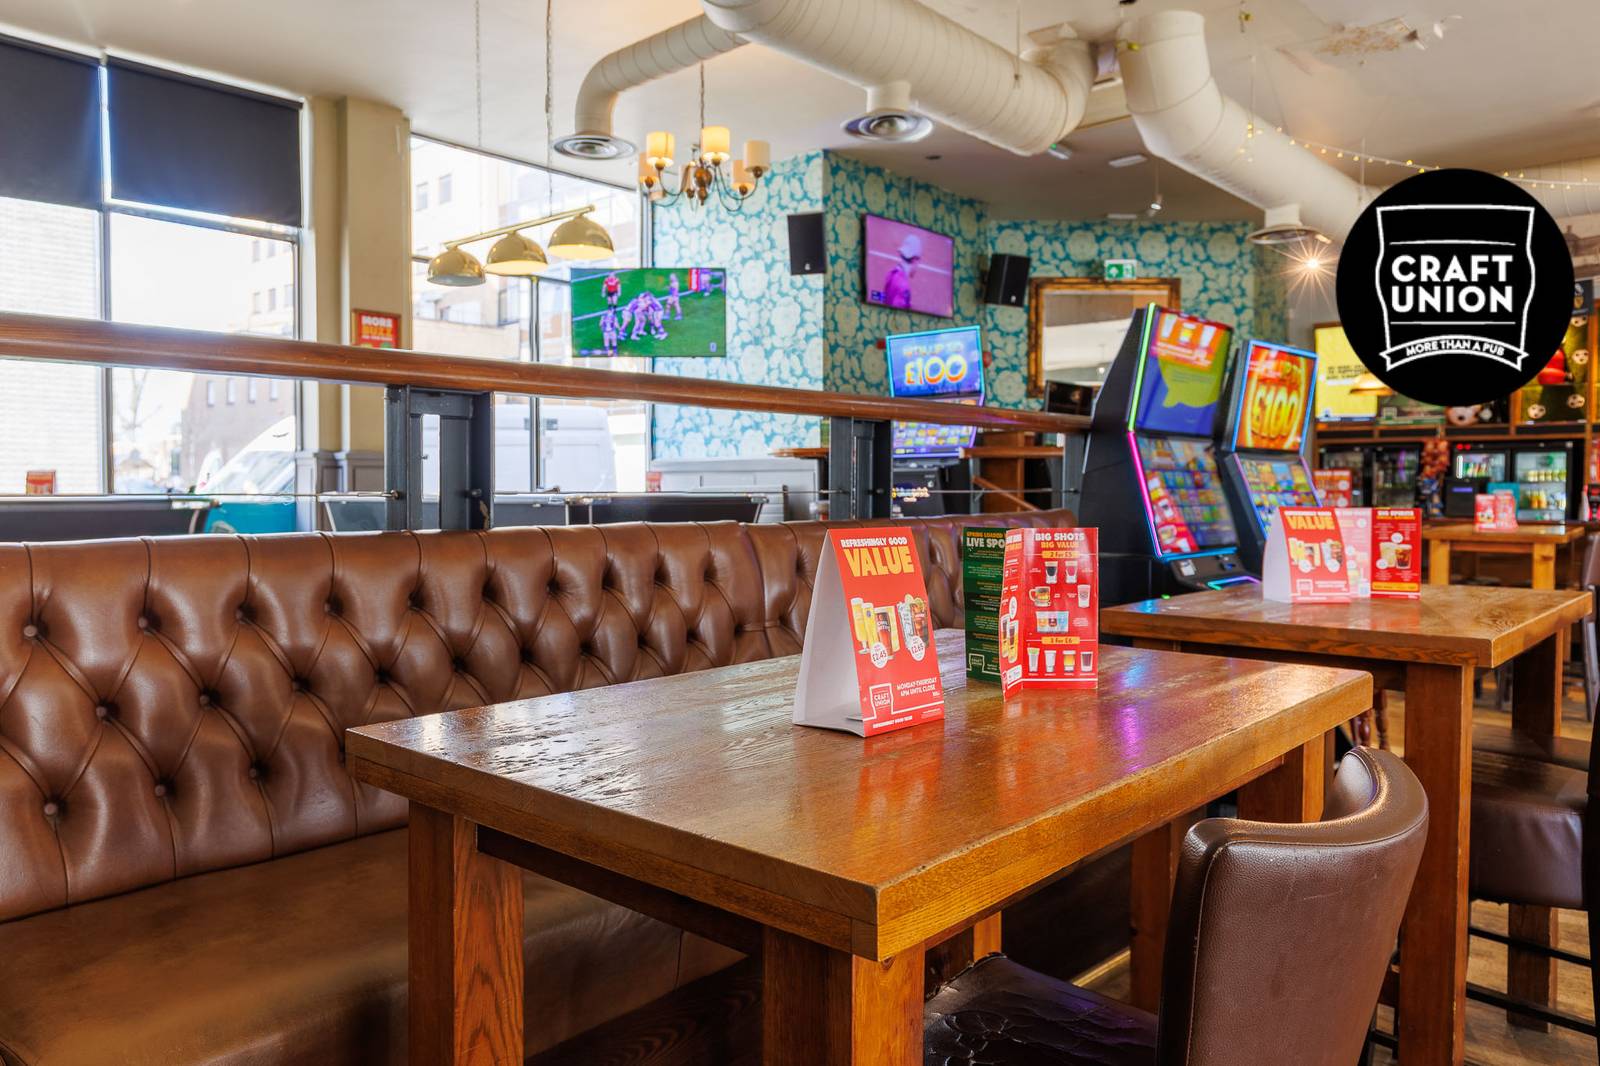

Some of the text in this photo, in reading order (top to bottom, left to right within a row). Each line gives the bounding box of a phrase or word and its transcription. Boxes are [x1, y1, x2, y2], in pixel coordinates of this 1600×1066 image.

[361, 315, 393, 328] MORE
[904, 354, 968, 385] £100
[1285, 515, 1335, 530] VALUE
[840, 536, 908, 548] REFRESHINGLY GOOD
[966, 537, 985, 548] LIVE
[986, 538, 1005, 549] SPO
[1035, 533, 1085, 541] BIG SHOTS
[843, 546, 915, 577] VALUE
[872, 650, 887, 662] £2.45
[923, 684, 936, 692] CLOSE
[873, 692, 890, 701] CRAFT
[874, 699, 891, 707] UNION
